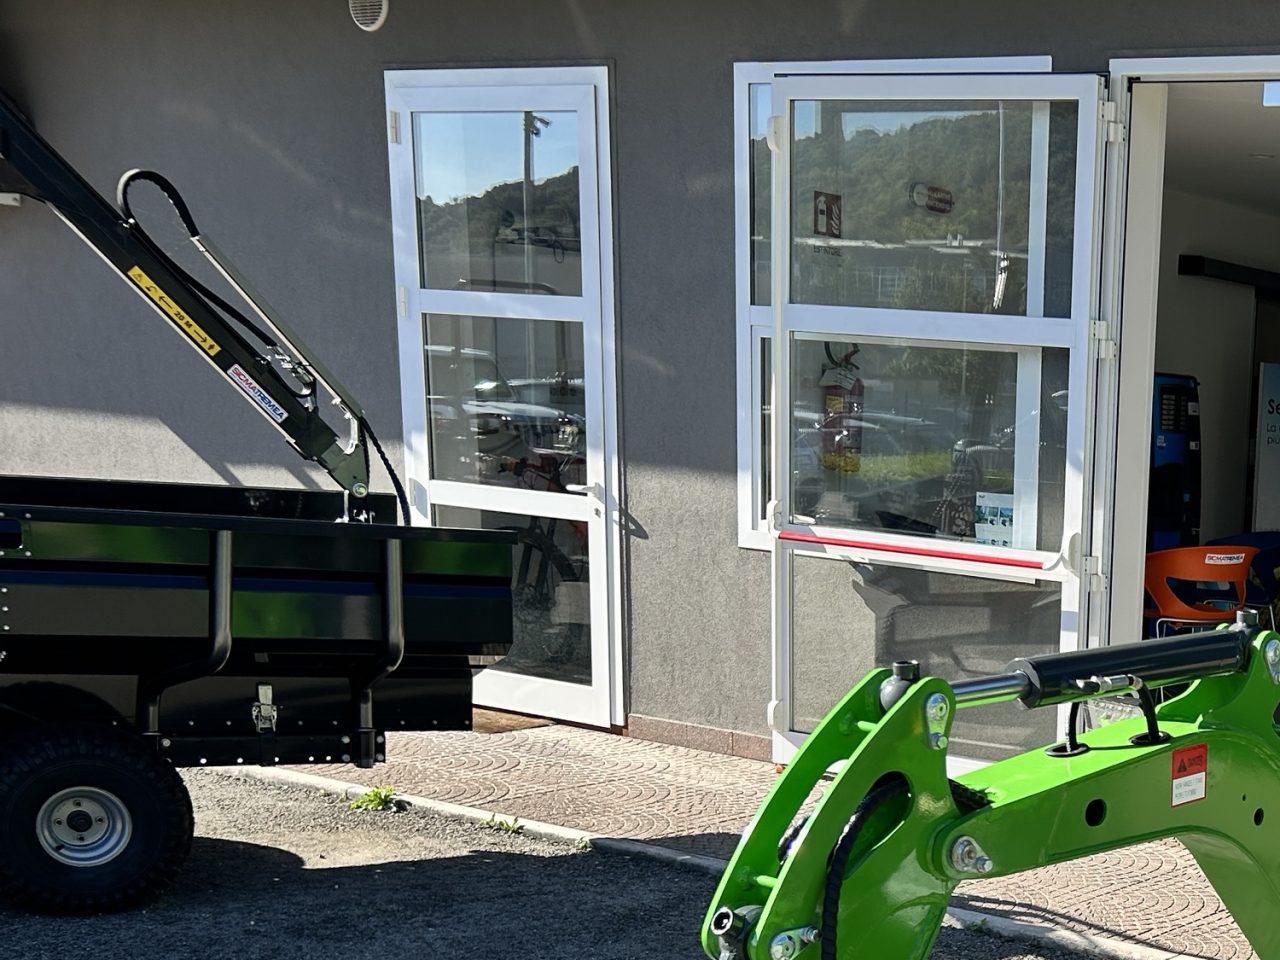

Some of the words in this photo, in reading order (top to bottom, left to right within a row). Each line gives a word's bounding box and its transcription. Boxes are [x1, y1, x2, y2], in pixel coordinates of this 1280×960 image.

[173, 310, 185, 322] 20
[184, 319, 193, 329] M
[1266, 423, 1277, 433] La
